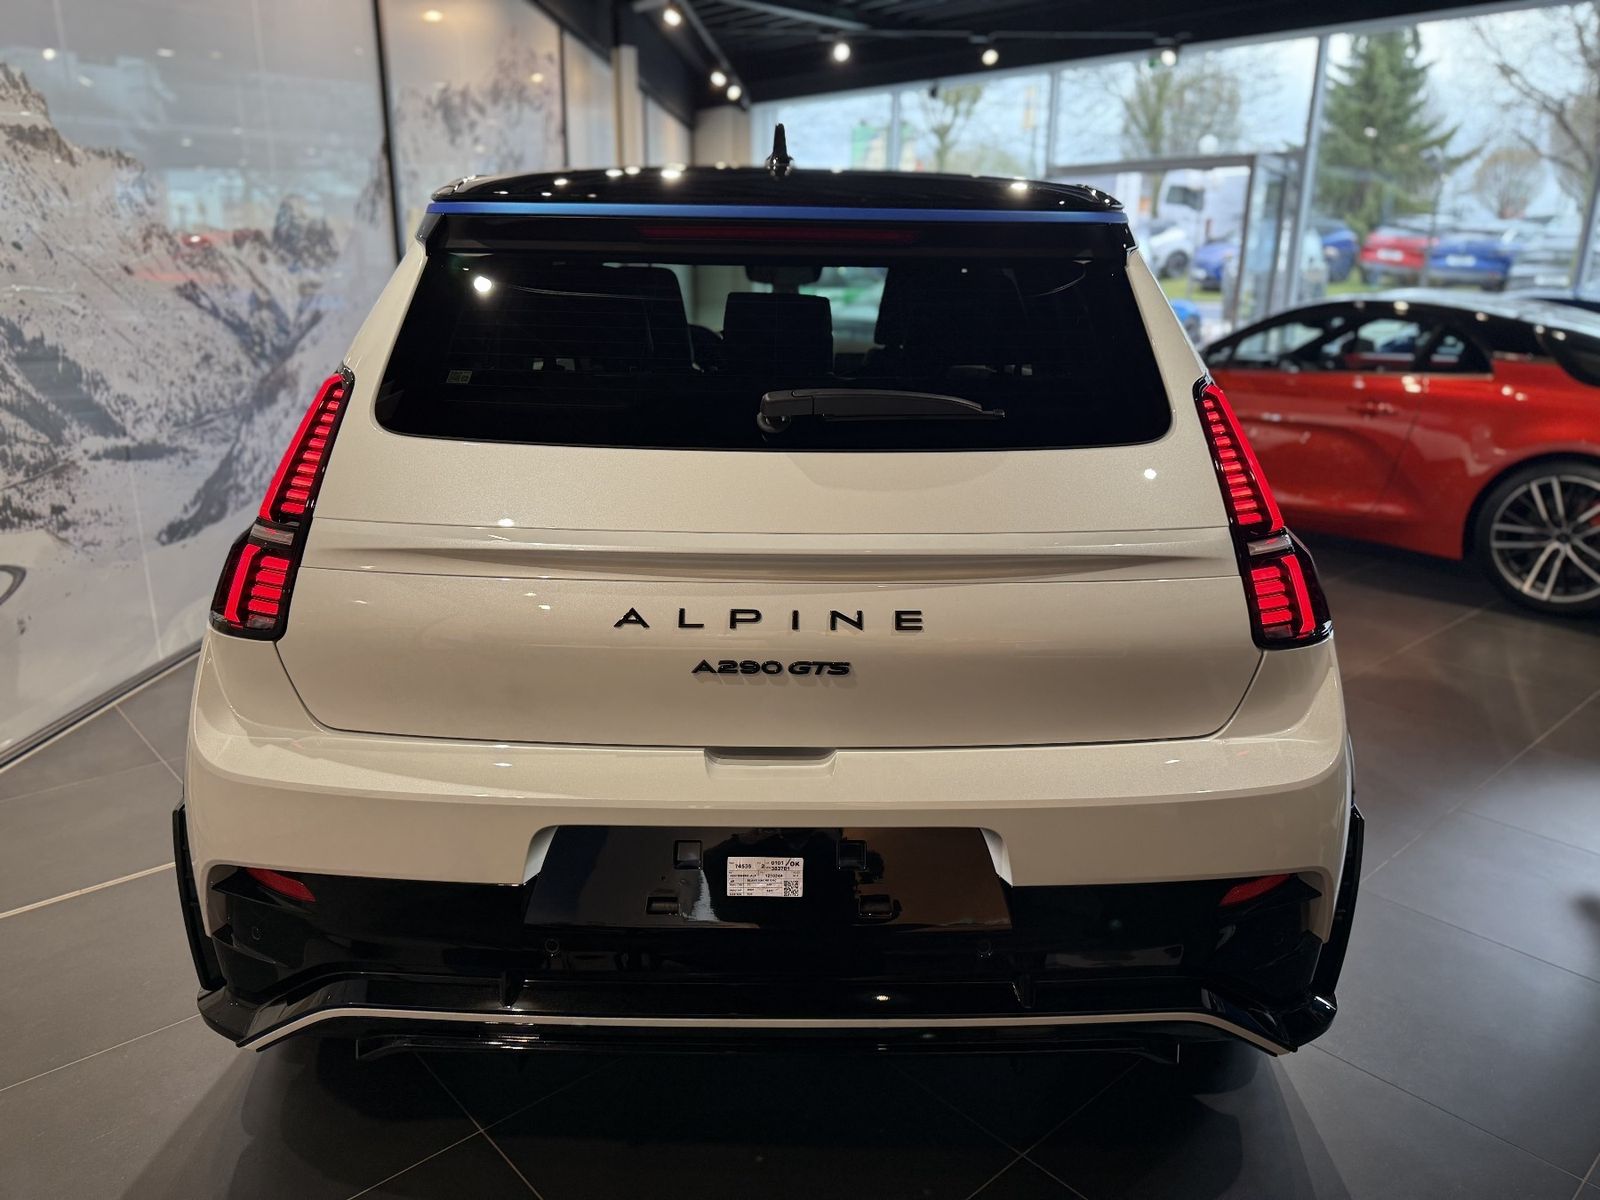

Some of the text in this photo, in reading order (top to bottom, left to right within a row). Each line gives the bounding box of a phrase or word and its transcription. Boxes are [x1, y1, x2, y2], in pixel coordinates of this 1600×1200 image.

[613, 607, 923, 631] ALPINE
[691, 659, 850, 676] A290 GTS
